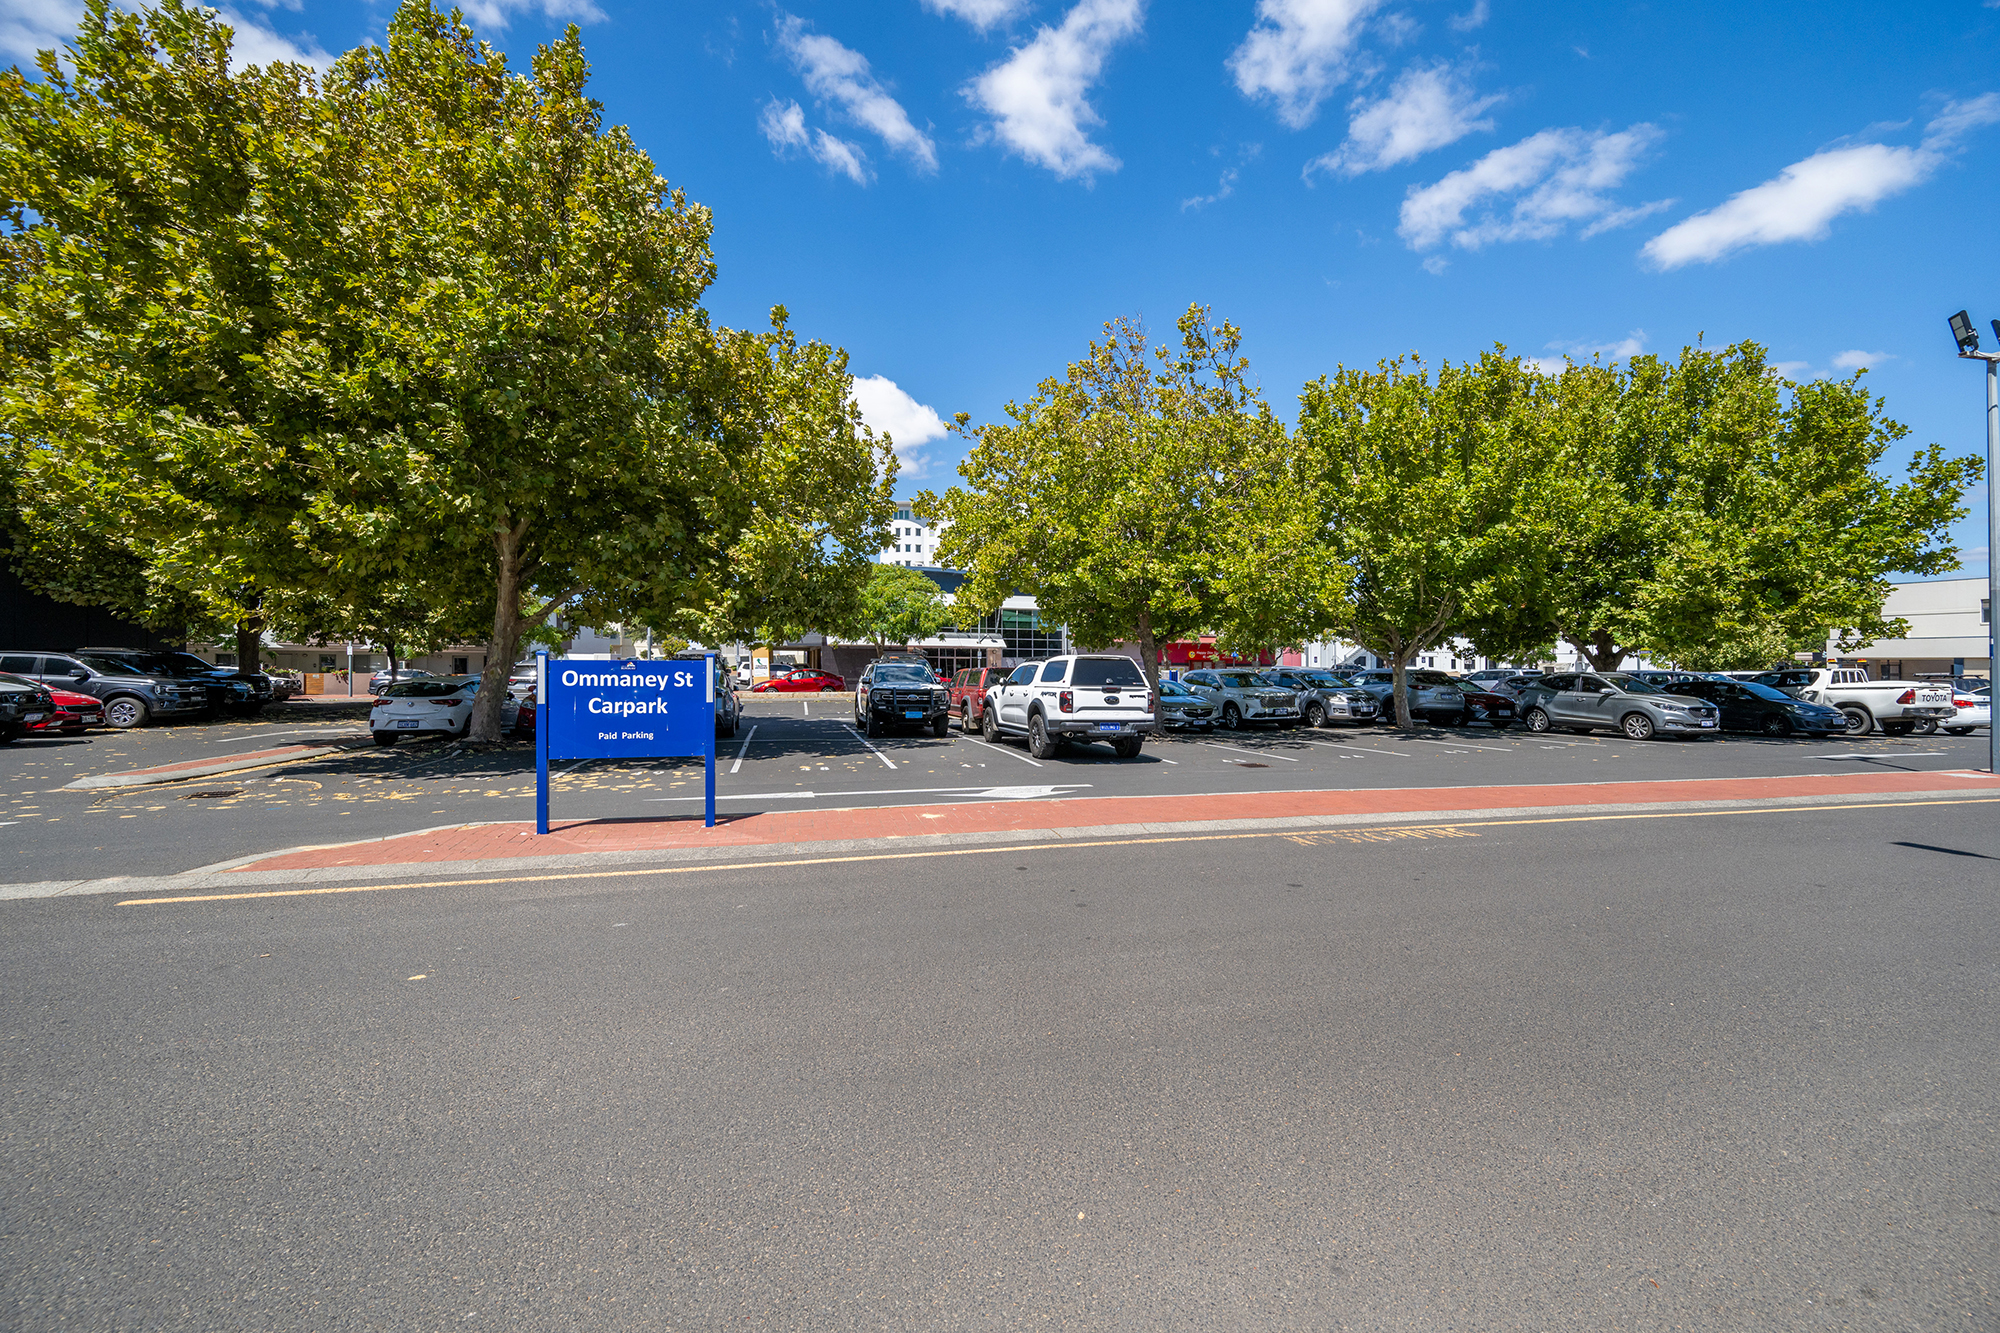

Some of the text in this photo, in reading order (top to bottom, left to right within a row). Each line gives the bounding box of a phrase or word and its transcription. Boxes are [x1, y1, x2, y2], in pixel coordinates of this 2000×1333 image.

[562, 670, 693, 691] Ommaney St
[1922, 694, 1947, 702] TOYOTA
[588, 697, 668, 717] Carpark
[598, 731, 654, 740] Paid Parking
